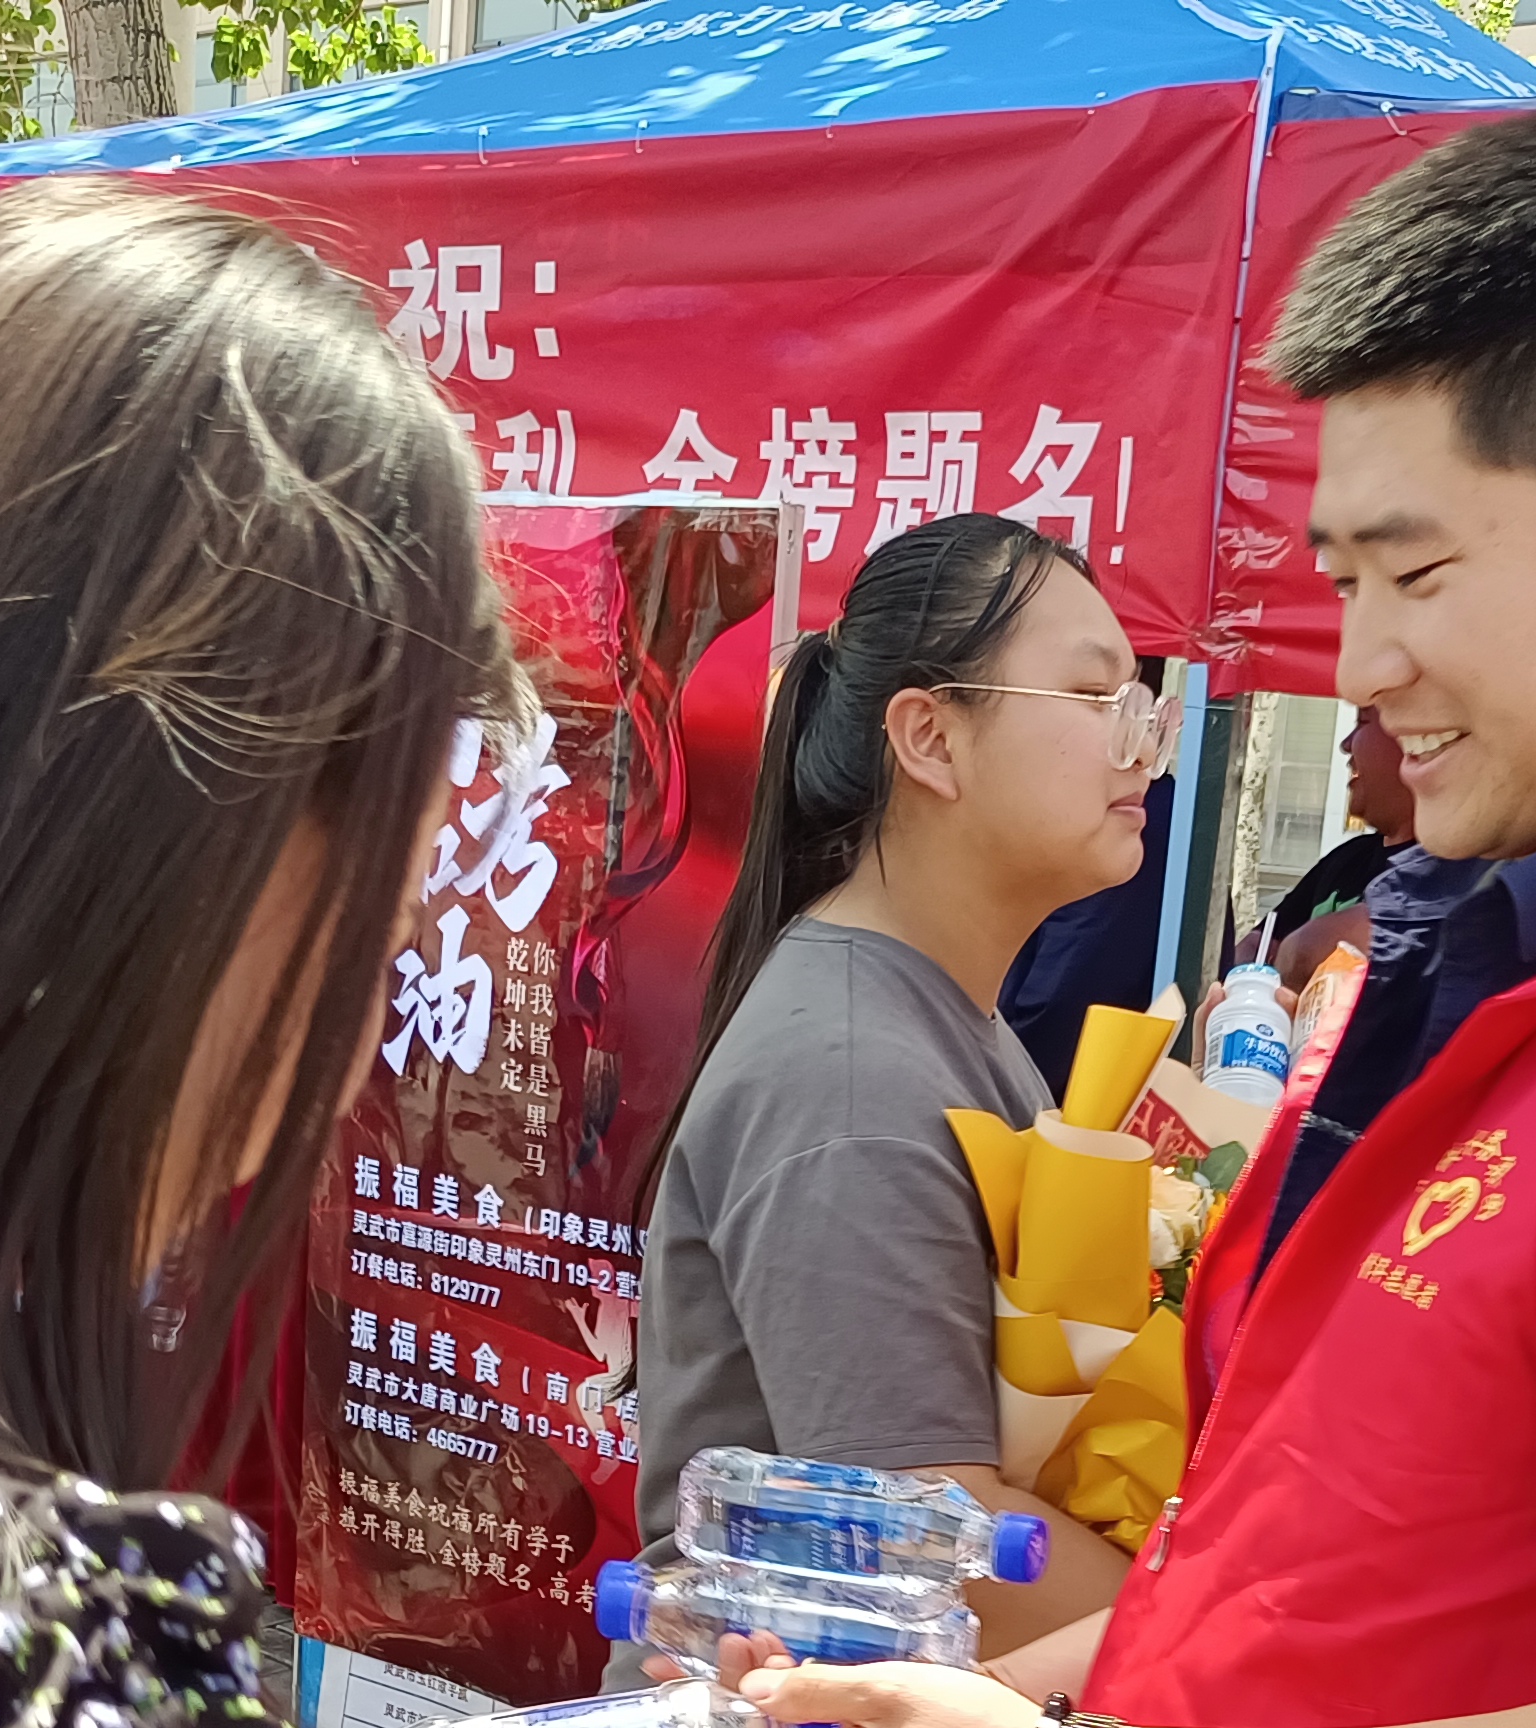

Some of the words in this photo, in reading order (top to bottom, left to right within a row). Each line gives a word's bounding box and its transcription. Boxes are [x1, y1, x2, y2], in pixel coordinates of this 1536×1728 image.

[454, 409, 576, 497] 利
[500, 938, 530, 1094] 乾坤未定
[522, 942, 556, 1178] 你我皆是黑马
[354, 1154, 647, 1258] 振福美食（印象灵州
[566, 1262, 613, 1293] 19-2
[346, 1360, 520, 1434] 灵武市大唐商业广场
[525, 1411, 590, 1450] 19-13
[338, 1467, 575, 1565] 振福美食祝福所有学子
